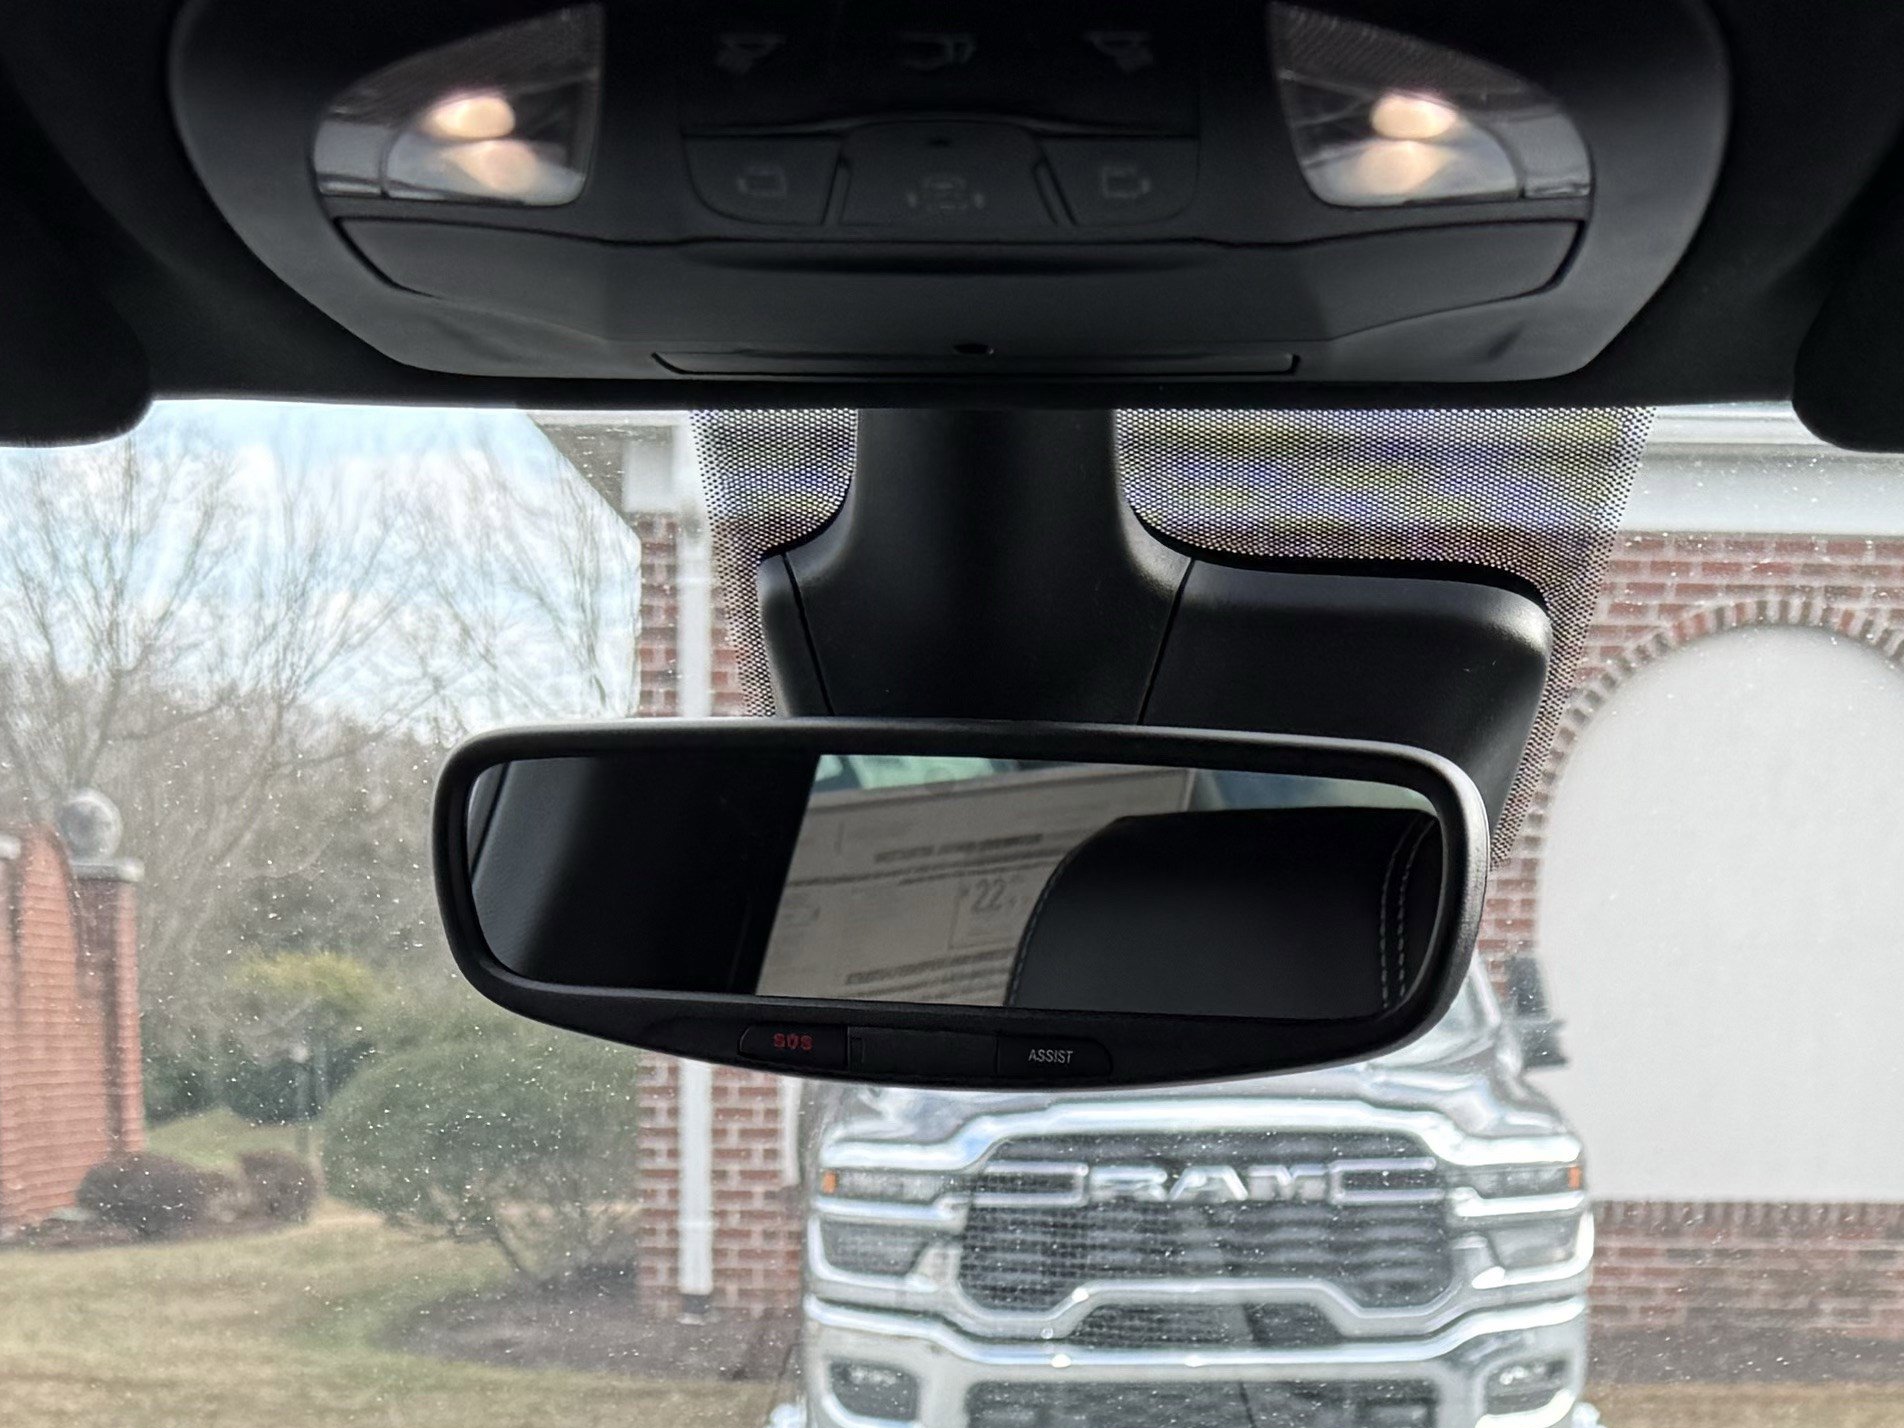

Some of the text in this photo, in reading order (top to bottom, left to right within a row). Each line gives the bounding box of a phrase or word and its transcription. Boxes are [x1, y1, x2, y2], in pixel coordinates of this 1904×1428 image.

[772, 1033, 813, 1050] SOS
[1028, 1049, 1073, 1064] ASSIST
[1088, 1164, 1333, 1201] RAM
